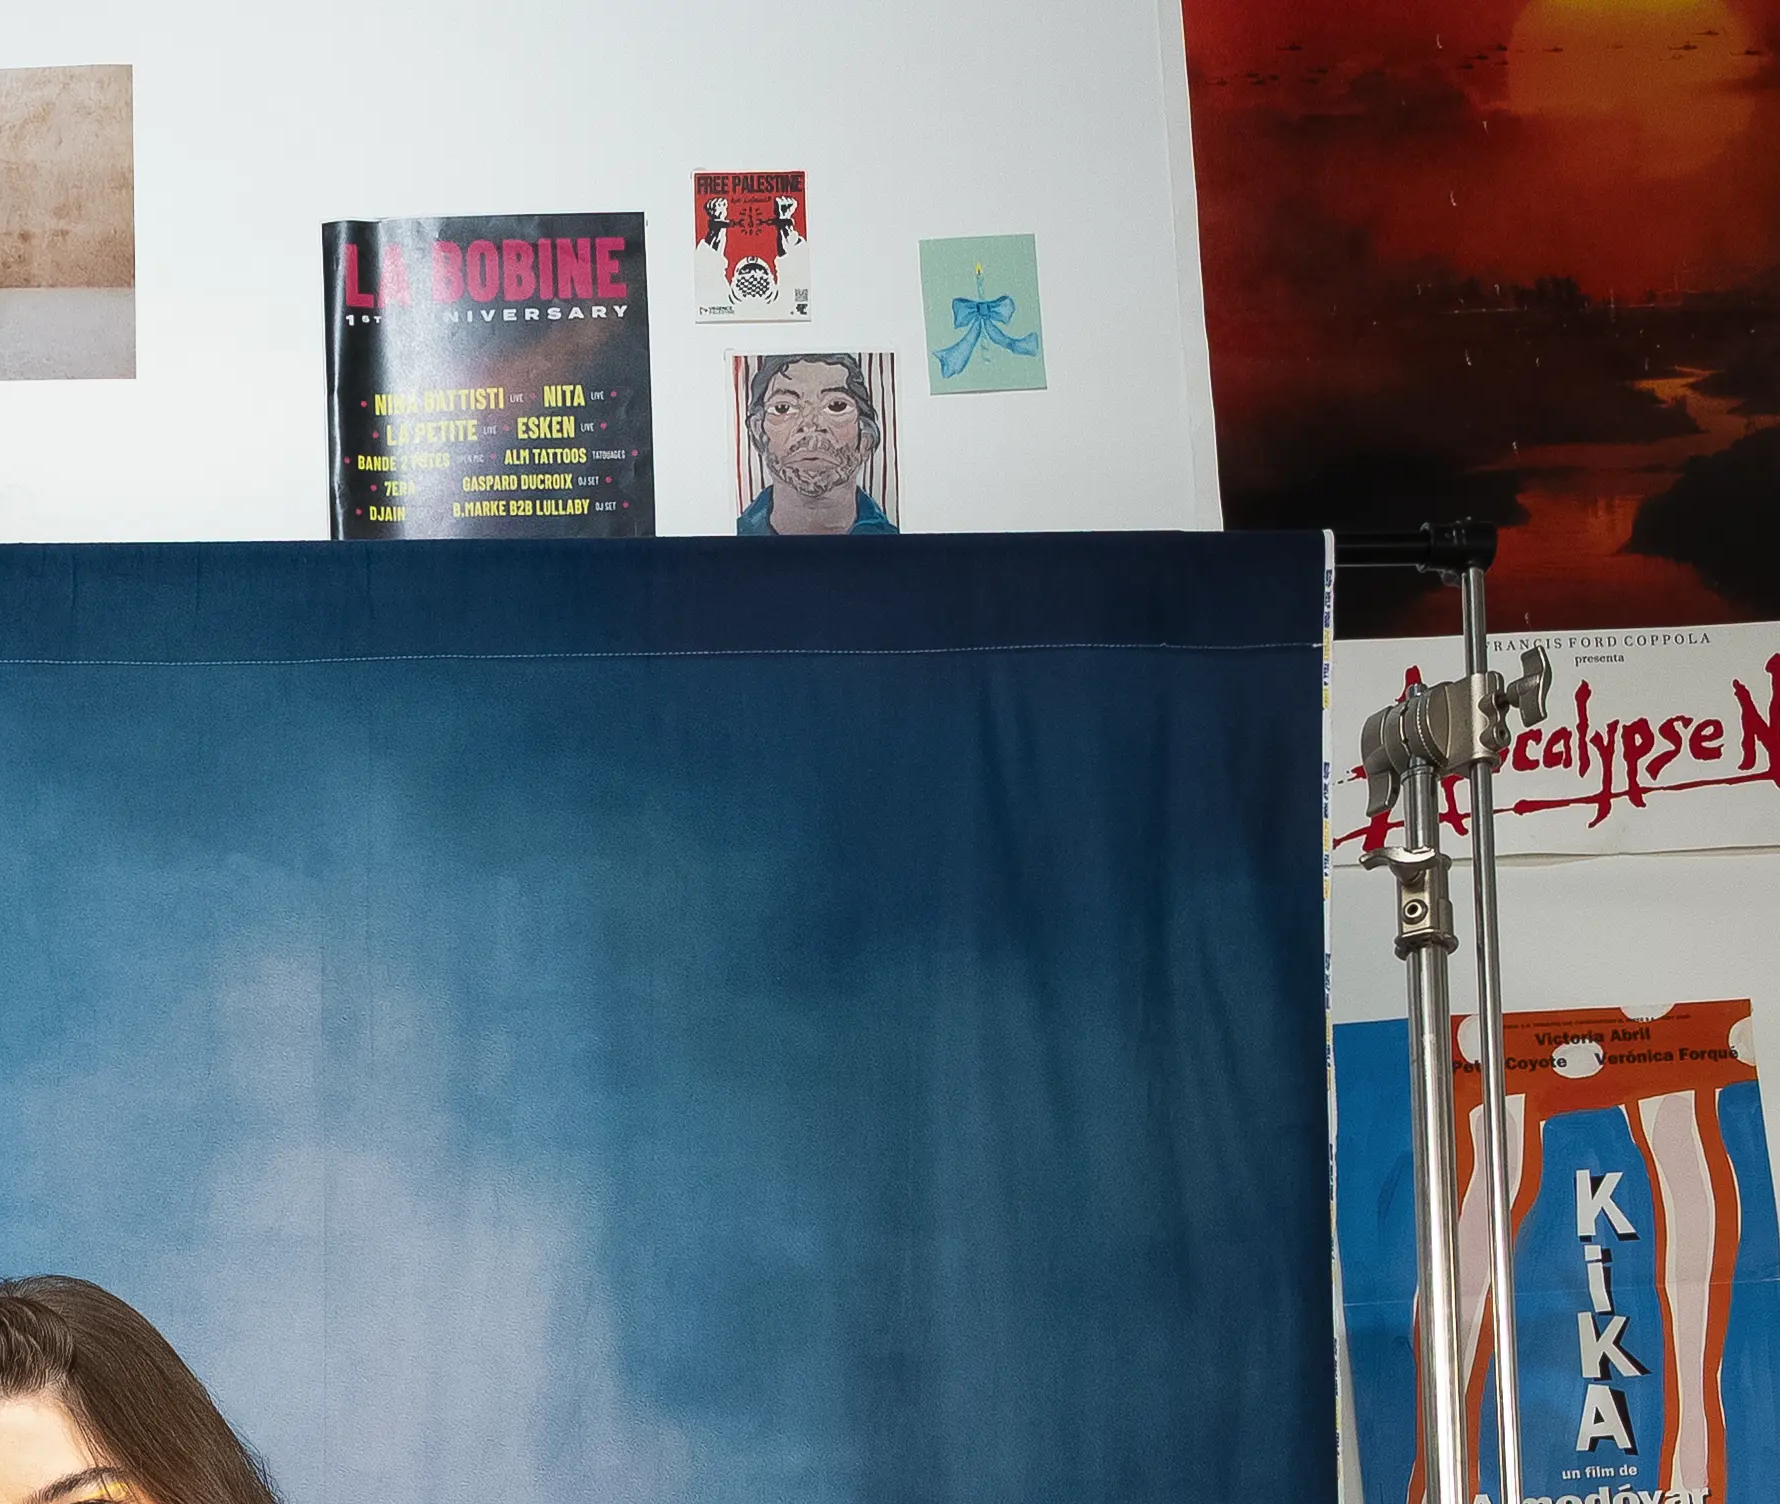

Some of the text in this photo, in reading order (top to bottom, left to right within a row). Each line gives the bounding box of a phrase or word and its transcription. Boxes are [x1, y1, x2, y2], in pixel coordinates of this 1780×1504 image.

[697, 174, 803, 194] FREE PALESTINE
[344, 237, 627, 309] LA BOBINE
[443, 304, 628, 323] NIVERSARY
[374, 393, 418, 416] NINA
[424, 387, 504, 413] BATTISTI
[543, 385, 586, 407] NITA
[590, 390, 605, 400] LIVE
[386, 423, 409, 446] LA
[413, 419, 478, 444] PETITE
[517, 416, 575, 439] ESKEN
[358, 454, 396, 471] BANDE
[504, 449, 530, 465] ALM
[532, 447, 587, 464] TATTOOS
[462, 475, 518, 492] GASPARD
[520, 473, 573, 490] DUCROIX
[453, 500, 507, 518] B.MARKE
[509, 500, 533, 517] B2B
[536, 499, 590, 516] LULLABY
[1568, 636, 1618, 650] FORD
[1623, 632, 1711, 648] COPPOLA
[1573, 652, 1626, 668] presenta
[1534, 1026, 1651, 1046] Victoria Abril
[1505, 1055, 1568, 1072] Coyote
[1593, 1047, 1675, 1067] Verónica
[1678, 1045, 1739, 1061] Forqué
[1561, 1463, 1638, 1480] un film de
